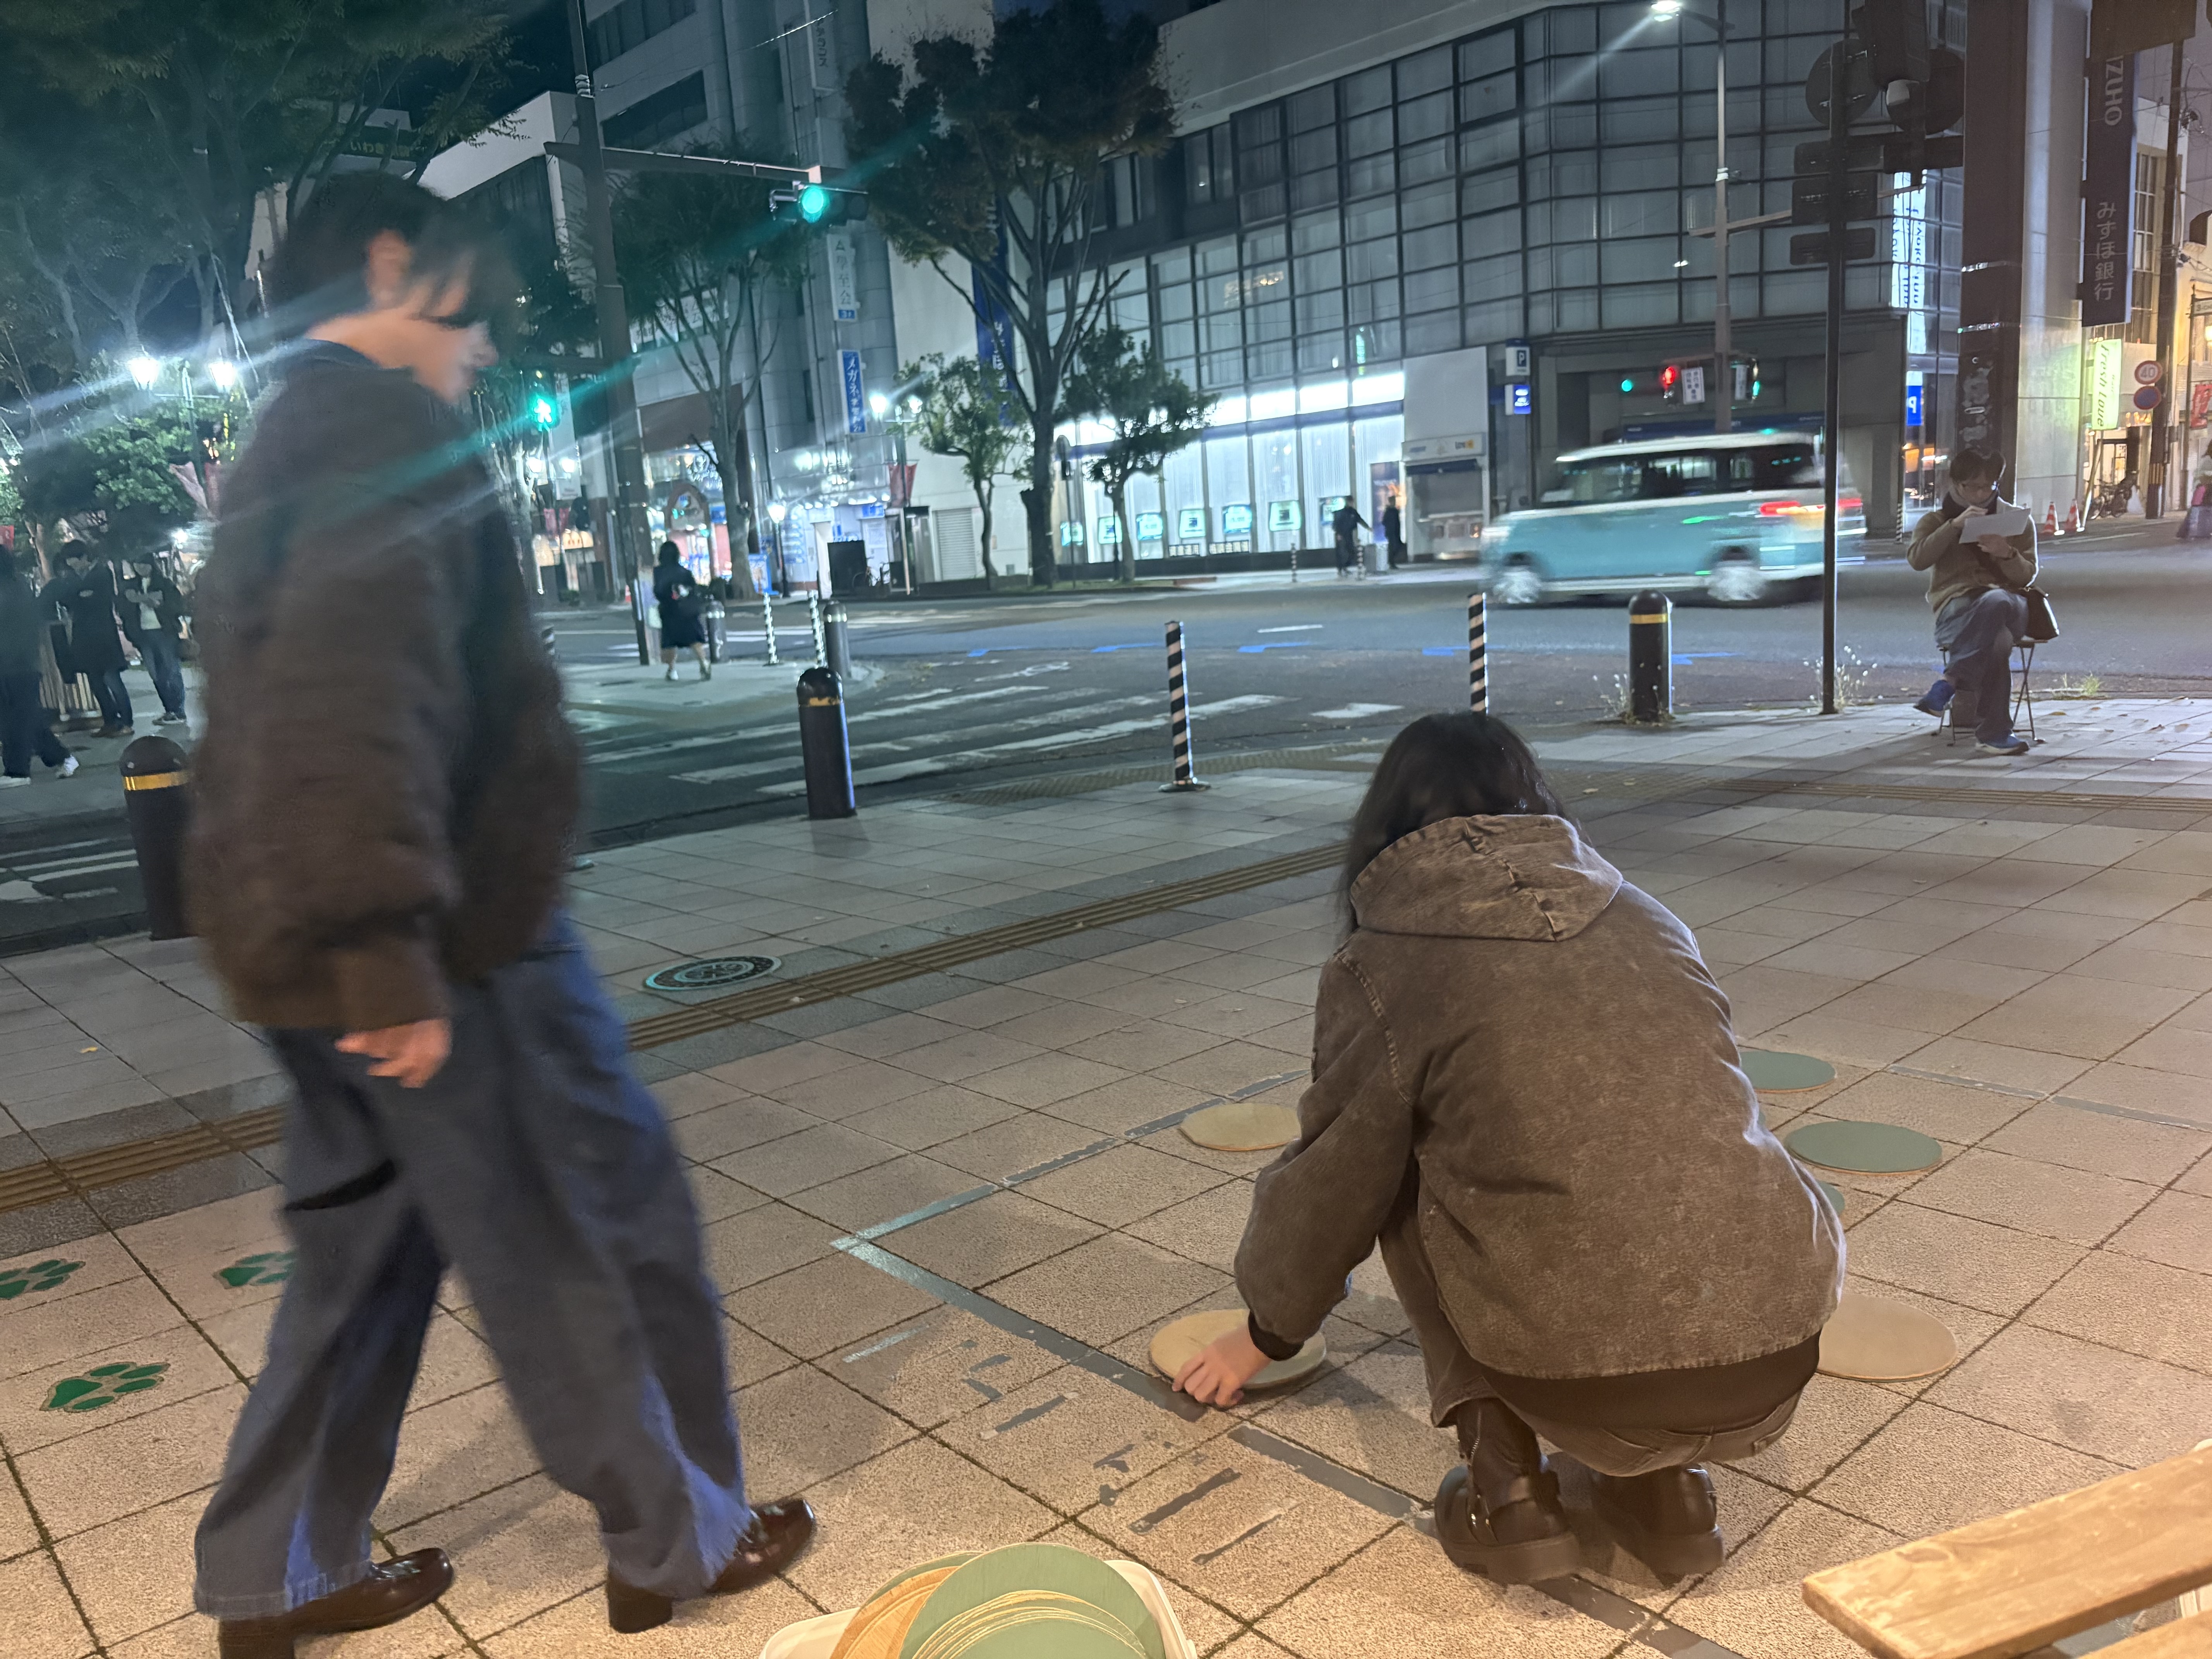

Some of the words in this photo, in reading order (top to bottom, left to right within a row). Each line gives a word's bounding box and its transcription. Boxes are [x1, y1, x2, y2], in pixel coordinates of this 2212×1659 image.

[2105, 55, 2124, 126] IZUHO
[2094, 201, 2116, 302] みずほ銀行
[1518, 352, 1525, 365] P
[2140, 366, 2156, 378] 40
